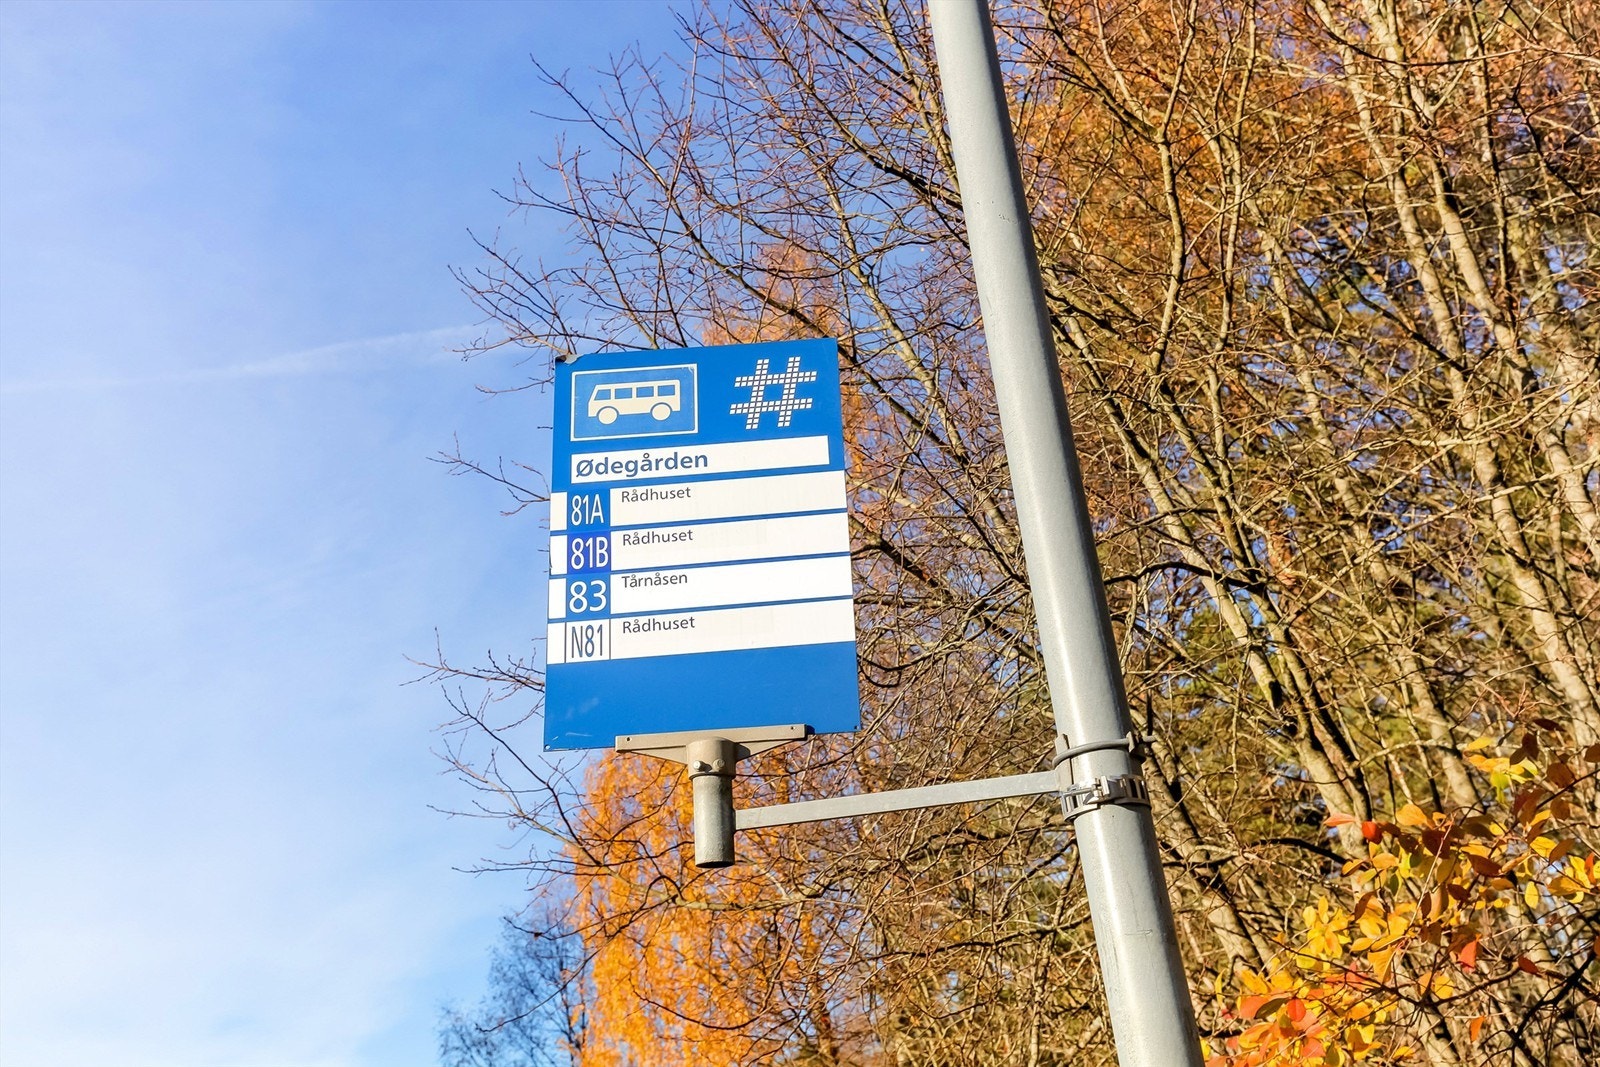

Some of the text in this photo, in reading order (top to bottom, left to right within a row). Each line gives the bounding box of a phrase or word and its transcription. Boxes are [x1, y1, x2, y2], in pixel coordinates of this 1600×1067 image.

[575, 452, 708, 478] Ødegården
[571, 487, 691, 526] 81A Rådhuset
[571, 529, 694, 570] 81B Rådhuset
[569, 572, 688, 613] 83 Tårnåsen
[571, 616, 696, 659] N81 Rådhuset
